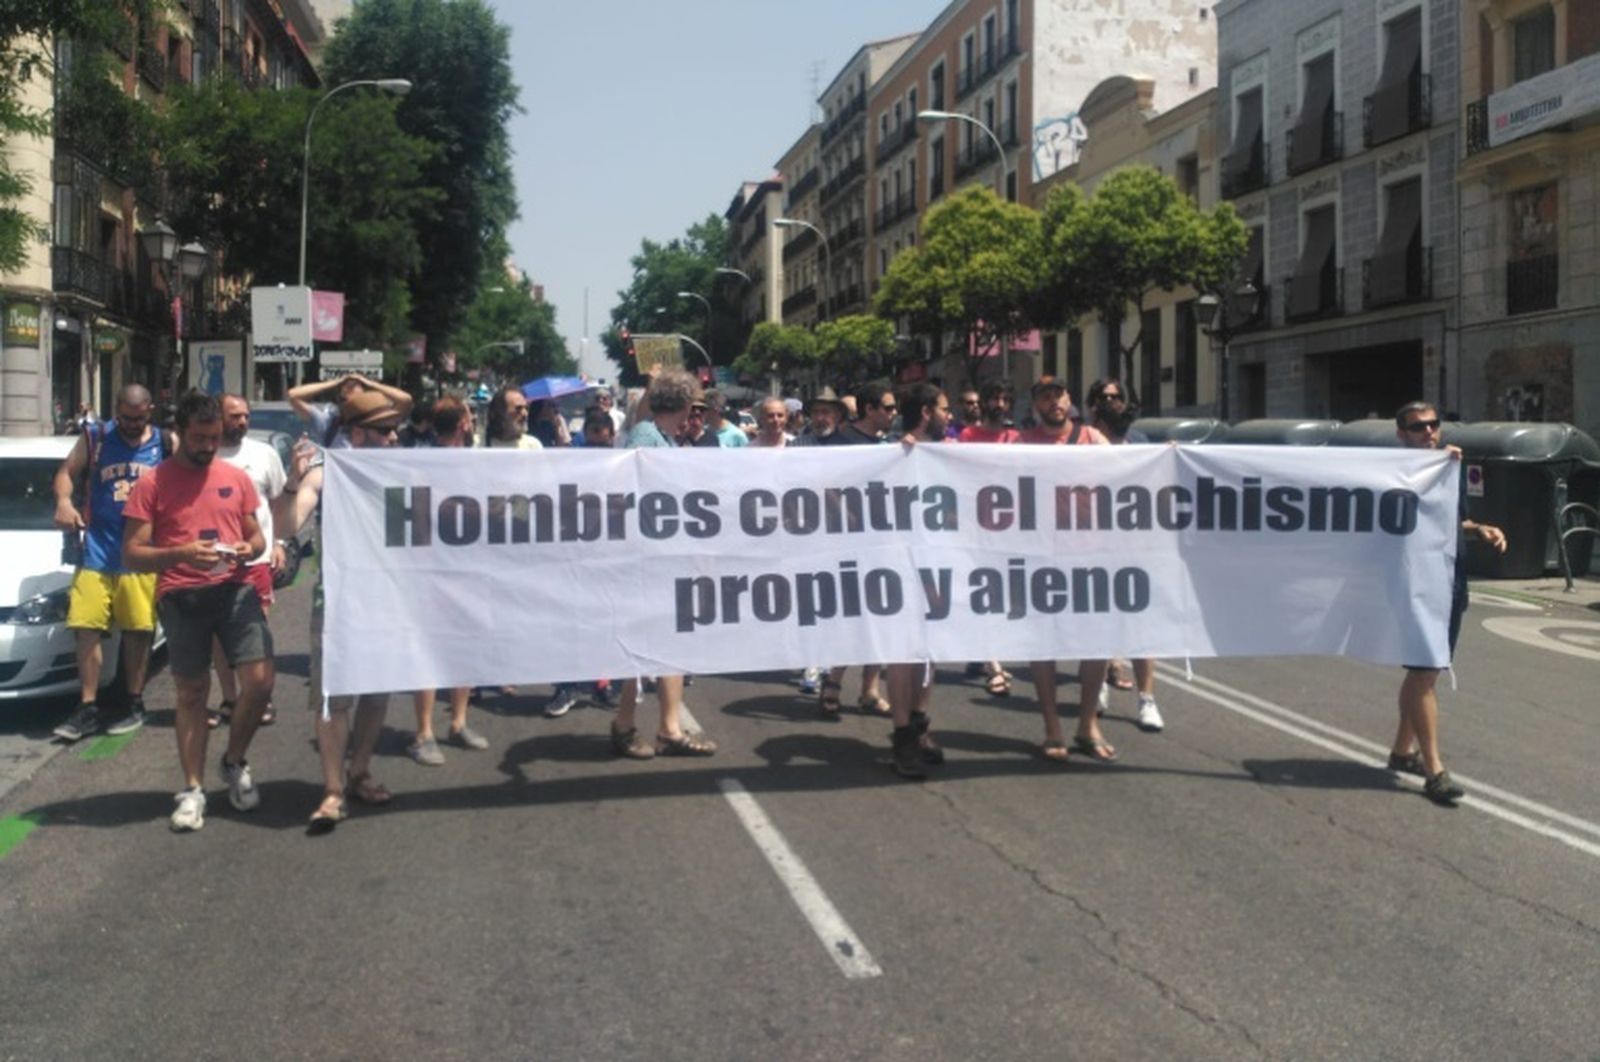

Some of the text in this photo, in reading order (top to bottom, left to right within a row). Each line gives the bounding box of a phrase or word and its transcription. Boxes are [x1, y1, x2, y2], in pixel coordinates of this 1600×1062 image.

[385, 475, 1418, 547] Hombres contra el machismo
[676, 558, 1150, 633] propio y ajeno
